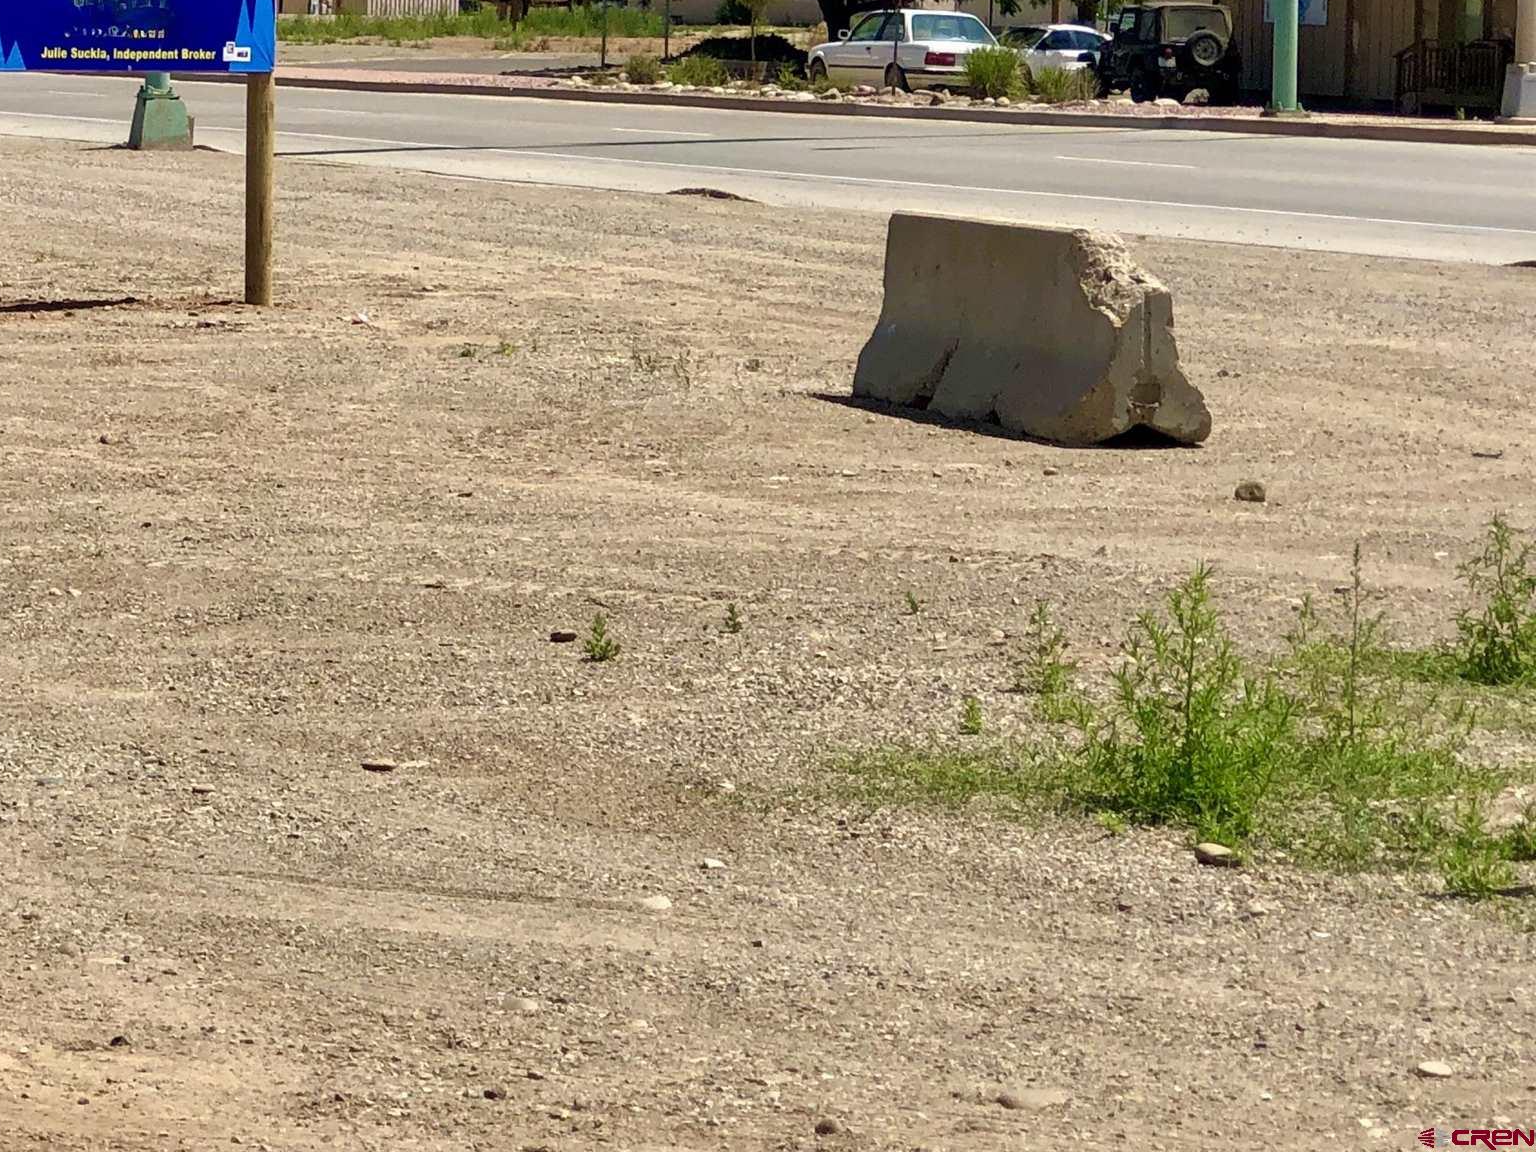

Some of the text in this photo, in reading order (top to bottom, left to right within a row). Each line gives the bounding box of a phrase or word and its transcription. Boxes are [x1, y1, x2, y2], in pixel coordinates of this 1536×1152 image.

[41, 46, 67, 59] Julie
[113, 47, 178, 62] Independent
[181, 48, 216, 60] Broker
